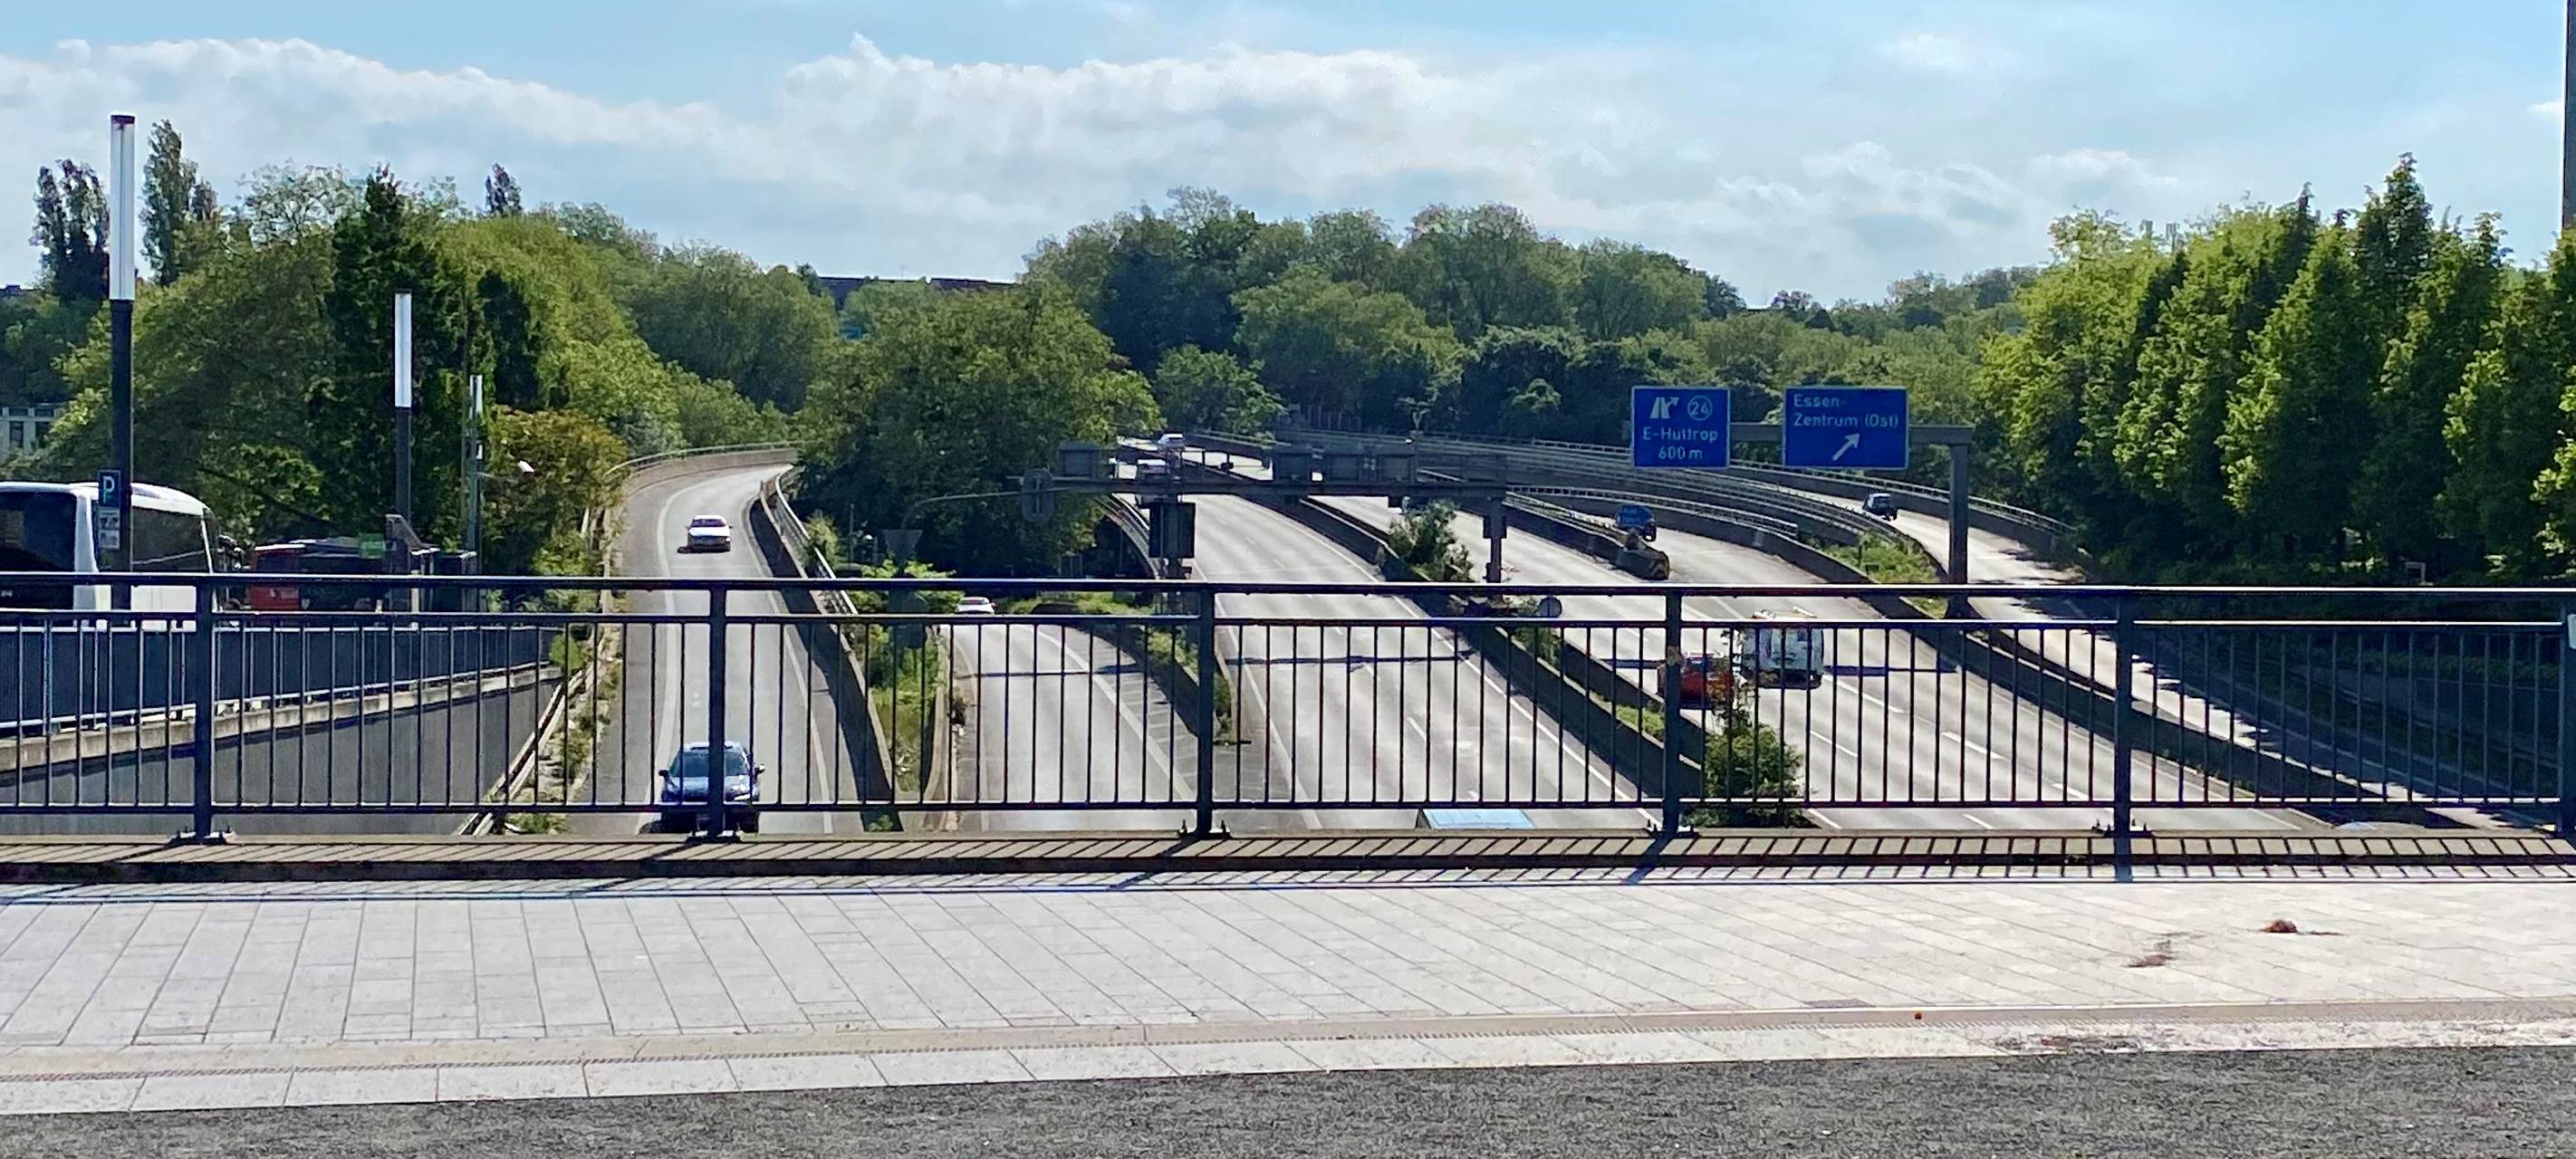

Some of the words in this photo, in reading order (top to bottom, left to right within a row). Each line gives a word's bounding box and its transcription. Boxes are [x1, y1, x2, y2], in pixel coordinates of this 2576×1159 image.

[1793, 394, 1848, 407] Essen-
[1793, 413, 1858, 427] Zentrum
[1865, 413, 1898, 428] (Ost)
[1643, 426, 1718, 444] E-Huttrop
[1658, 445, 1686, 460] 600
[1688, 449, 1704, 460] m
[102, 475, 115, 503] P
